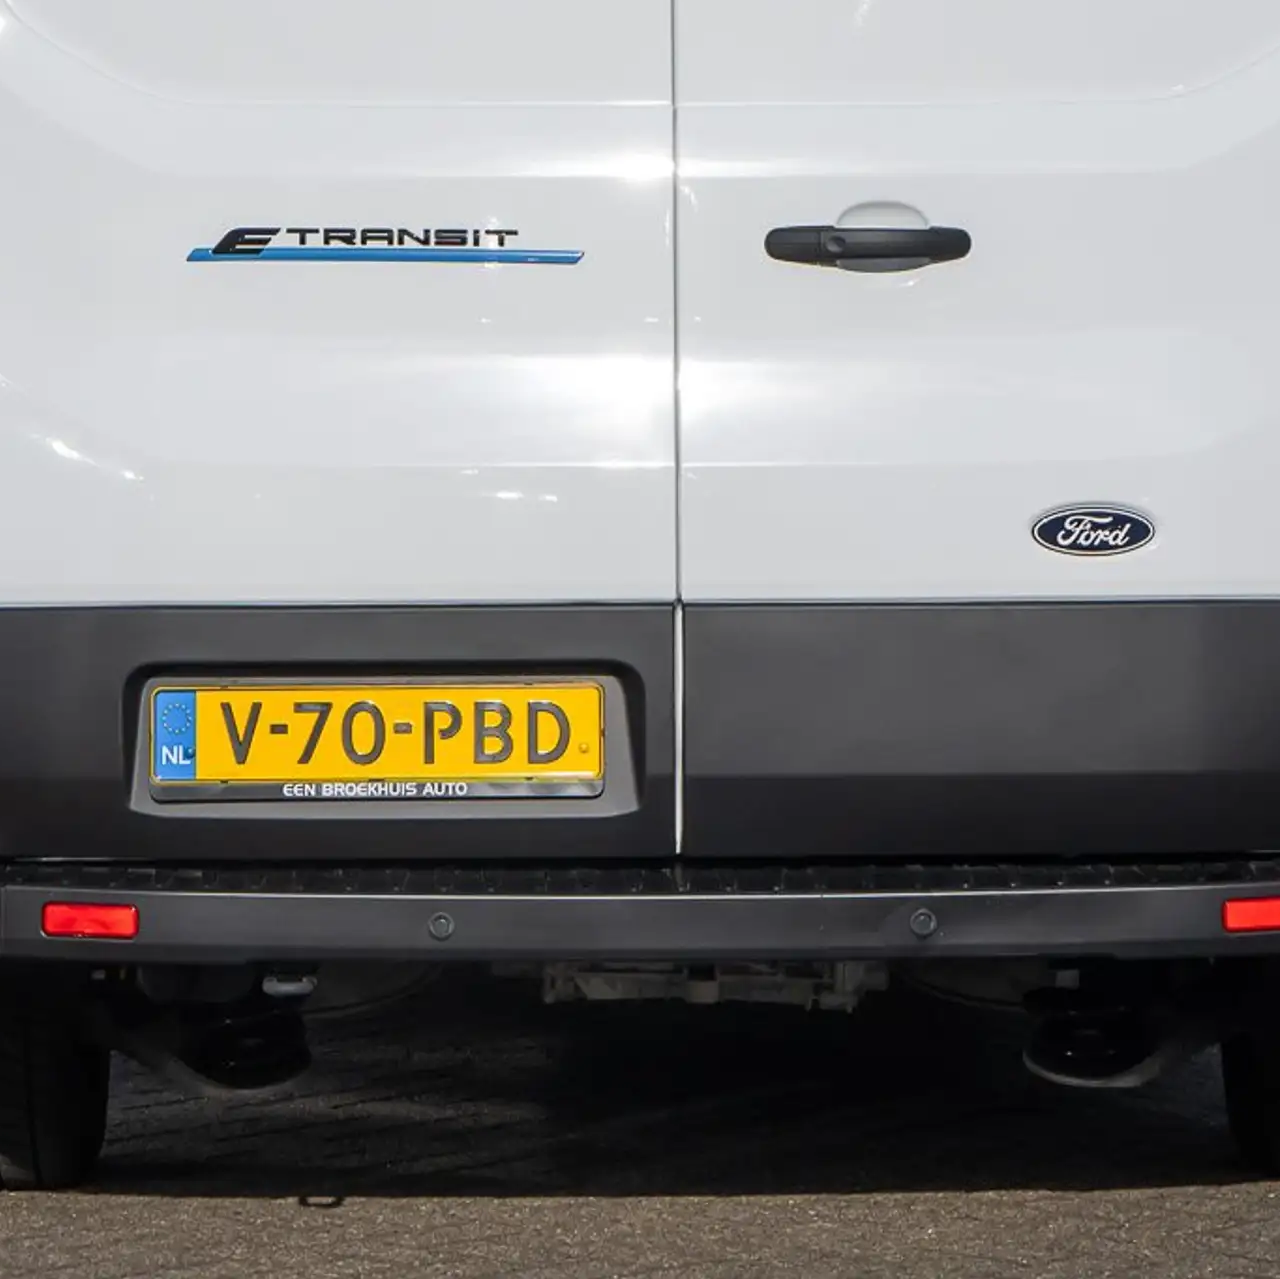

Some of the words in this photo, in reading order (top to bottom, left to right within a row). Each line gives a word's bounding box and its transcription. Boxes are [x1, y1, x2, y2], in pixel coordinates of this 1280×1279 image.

[1056, 515, 1131, 546] Ford
[220, 701, 571, 765] V-70-PBD
[161, 746, 191, 765] NL
[282, 783, 316, 796] EEN
[321, 783, 418, 796] BROEKHUIS
[422, 782, 468, 796] AUTO
